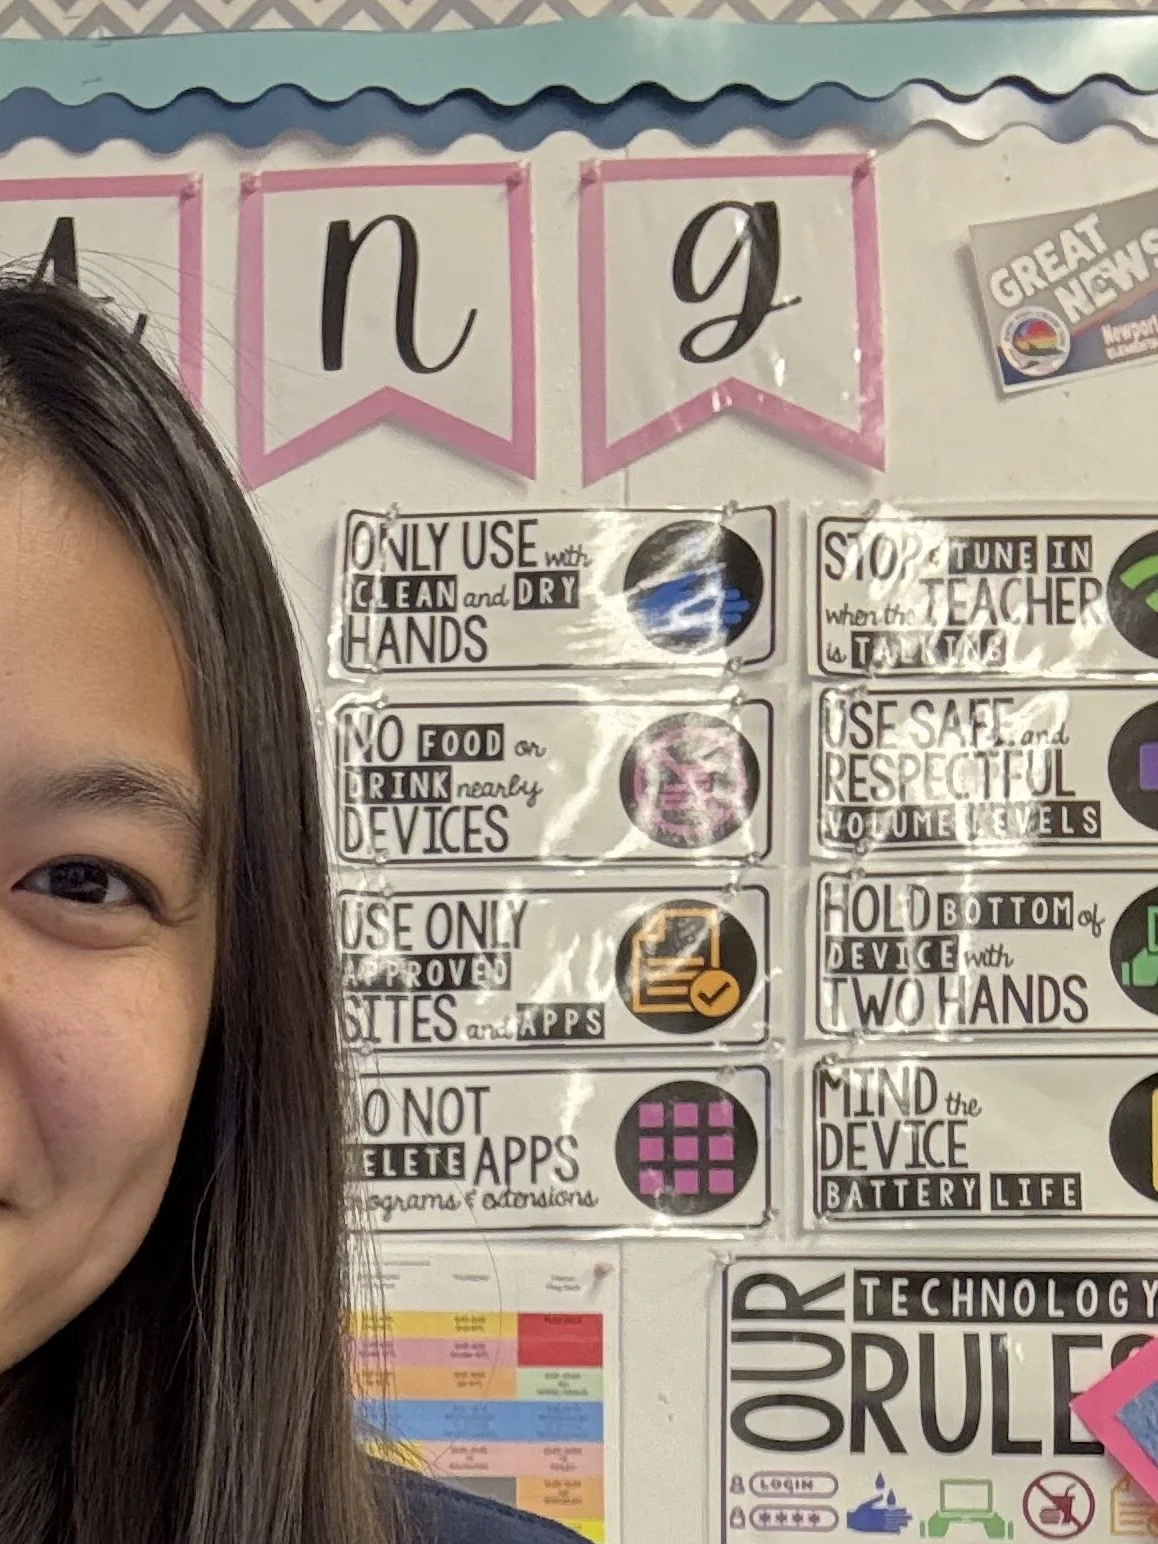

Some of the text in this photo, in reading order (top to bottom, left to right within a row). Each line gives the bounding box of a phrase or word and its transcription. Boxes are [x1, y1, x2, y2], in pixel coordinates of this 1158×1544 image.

[990, 212, 1108, 308] GREAT
[351, 518, 592, 572] ONLY USE with
[825, 531, 923, 581] STOP
[954, 541, 1033, 569] TUNE
[1051, 541, 1089, 569] IN
[354, 576, 578, 608] CLEAN and DRY
[826, 603, 877, 626] when
[920, 577, 1103, 626] TEACHER
[346, 614, 487, 664] HANDS
[826, 634, 1005, 667] is TALKING
[344, 714, 547, 762] NO FOOD or
[824, 698, 1070, 750] USE SAFE and
[350, 771, 543, 807] DRINK nearby
[824, 749, 1076, 802] RESPECTFUL
[343, 805, 509, 854] DEVICES
[825, 809, 952, 838] VOLUME
[342, 901, 528, 951] USE ONLY
[824, 884, 1105, 937] HOLD BOTTOM of
[344, 958, 508, 988] APPROVED
[829, 940, 1013, 970] DEVICE with
[343, 994, 603, 1043] SITES and APPS
[823, 974, 1089, 1026] TWO HANDS
[403, 1086, 490, 1136] NOT
[819, 1067, 981, 1118] MIND the
[363, 1135, 579, 1185] ELETE APPS
[822, 1120, 968, 1170] DEVICE
[366, 1191, 461, 1222] ograms
[827, 1177, 1077, 1209] BATTERY LIFE
[860, 1277, 1158, 1318] TECHNOLOGY
[730, 1273, 845, 1451] OUR
[760, 1478, 813, 1492] LOGIN
